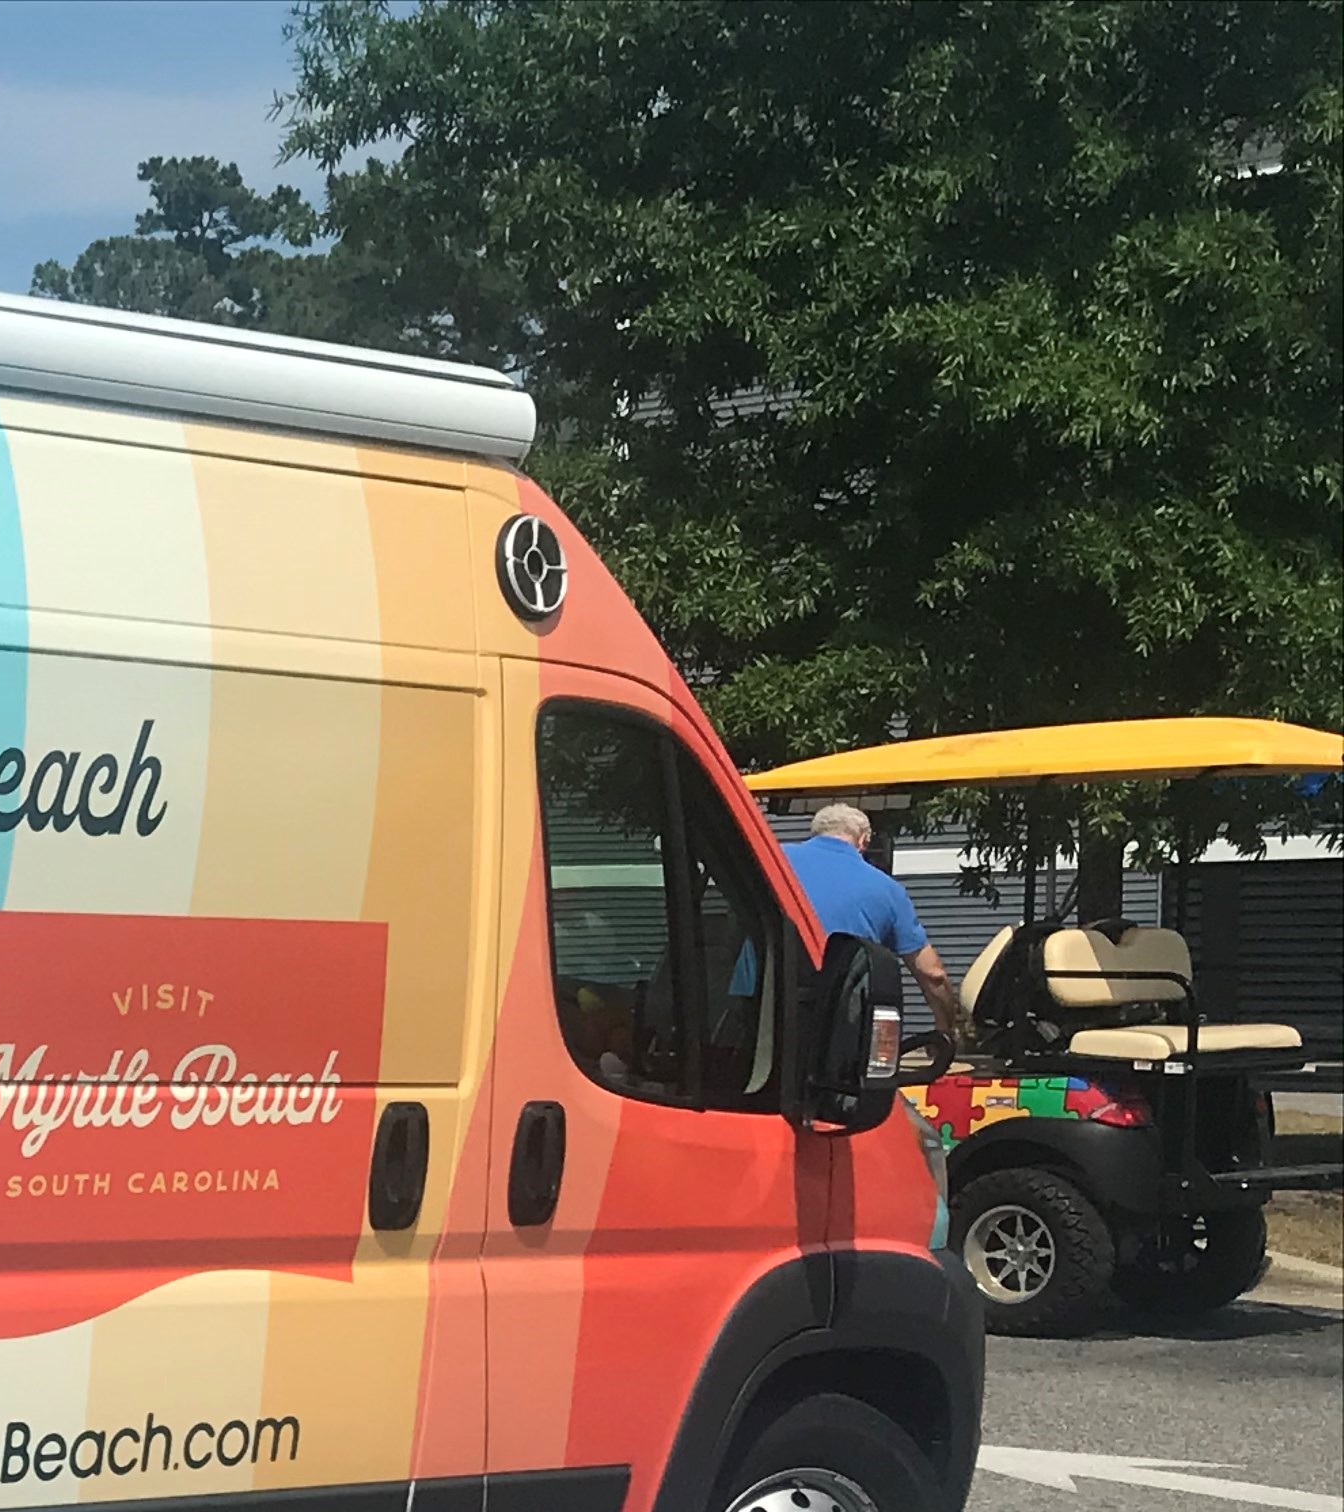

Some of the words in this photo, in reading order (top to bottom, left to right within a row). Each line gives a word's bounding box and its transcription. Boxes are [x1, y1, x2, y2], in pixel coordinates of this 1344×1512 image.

[112, 983, 215, 1018] VISIT
[169, 1044, 343, 1130] Beach
[5, 1173, 111, 1198] SOUTH
[127, 1168, 280, 1195] CAROLINA
